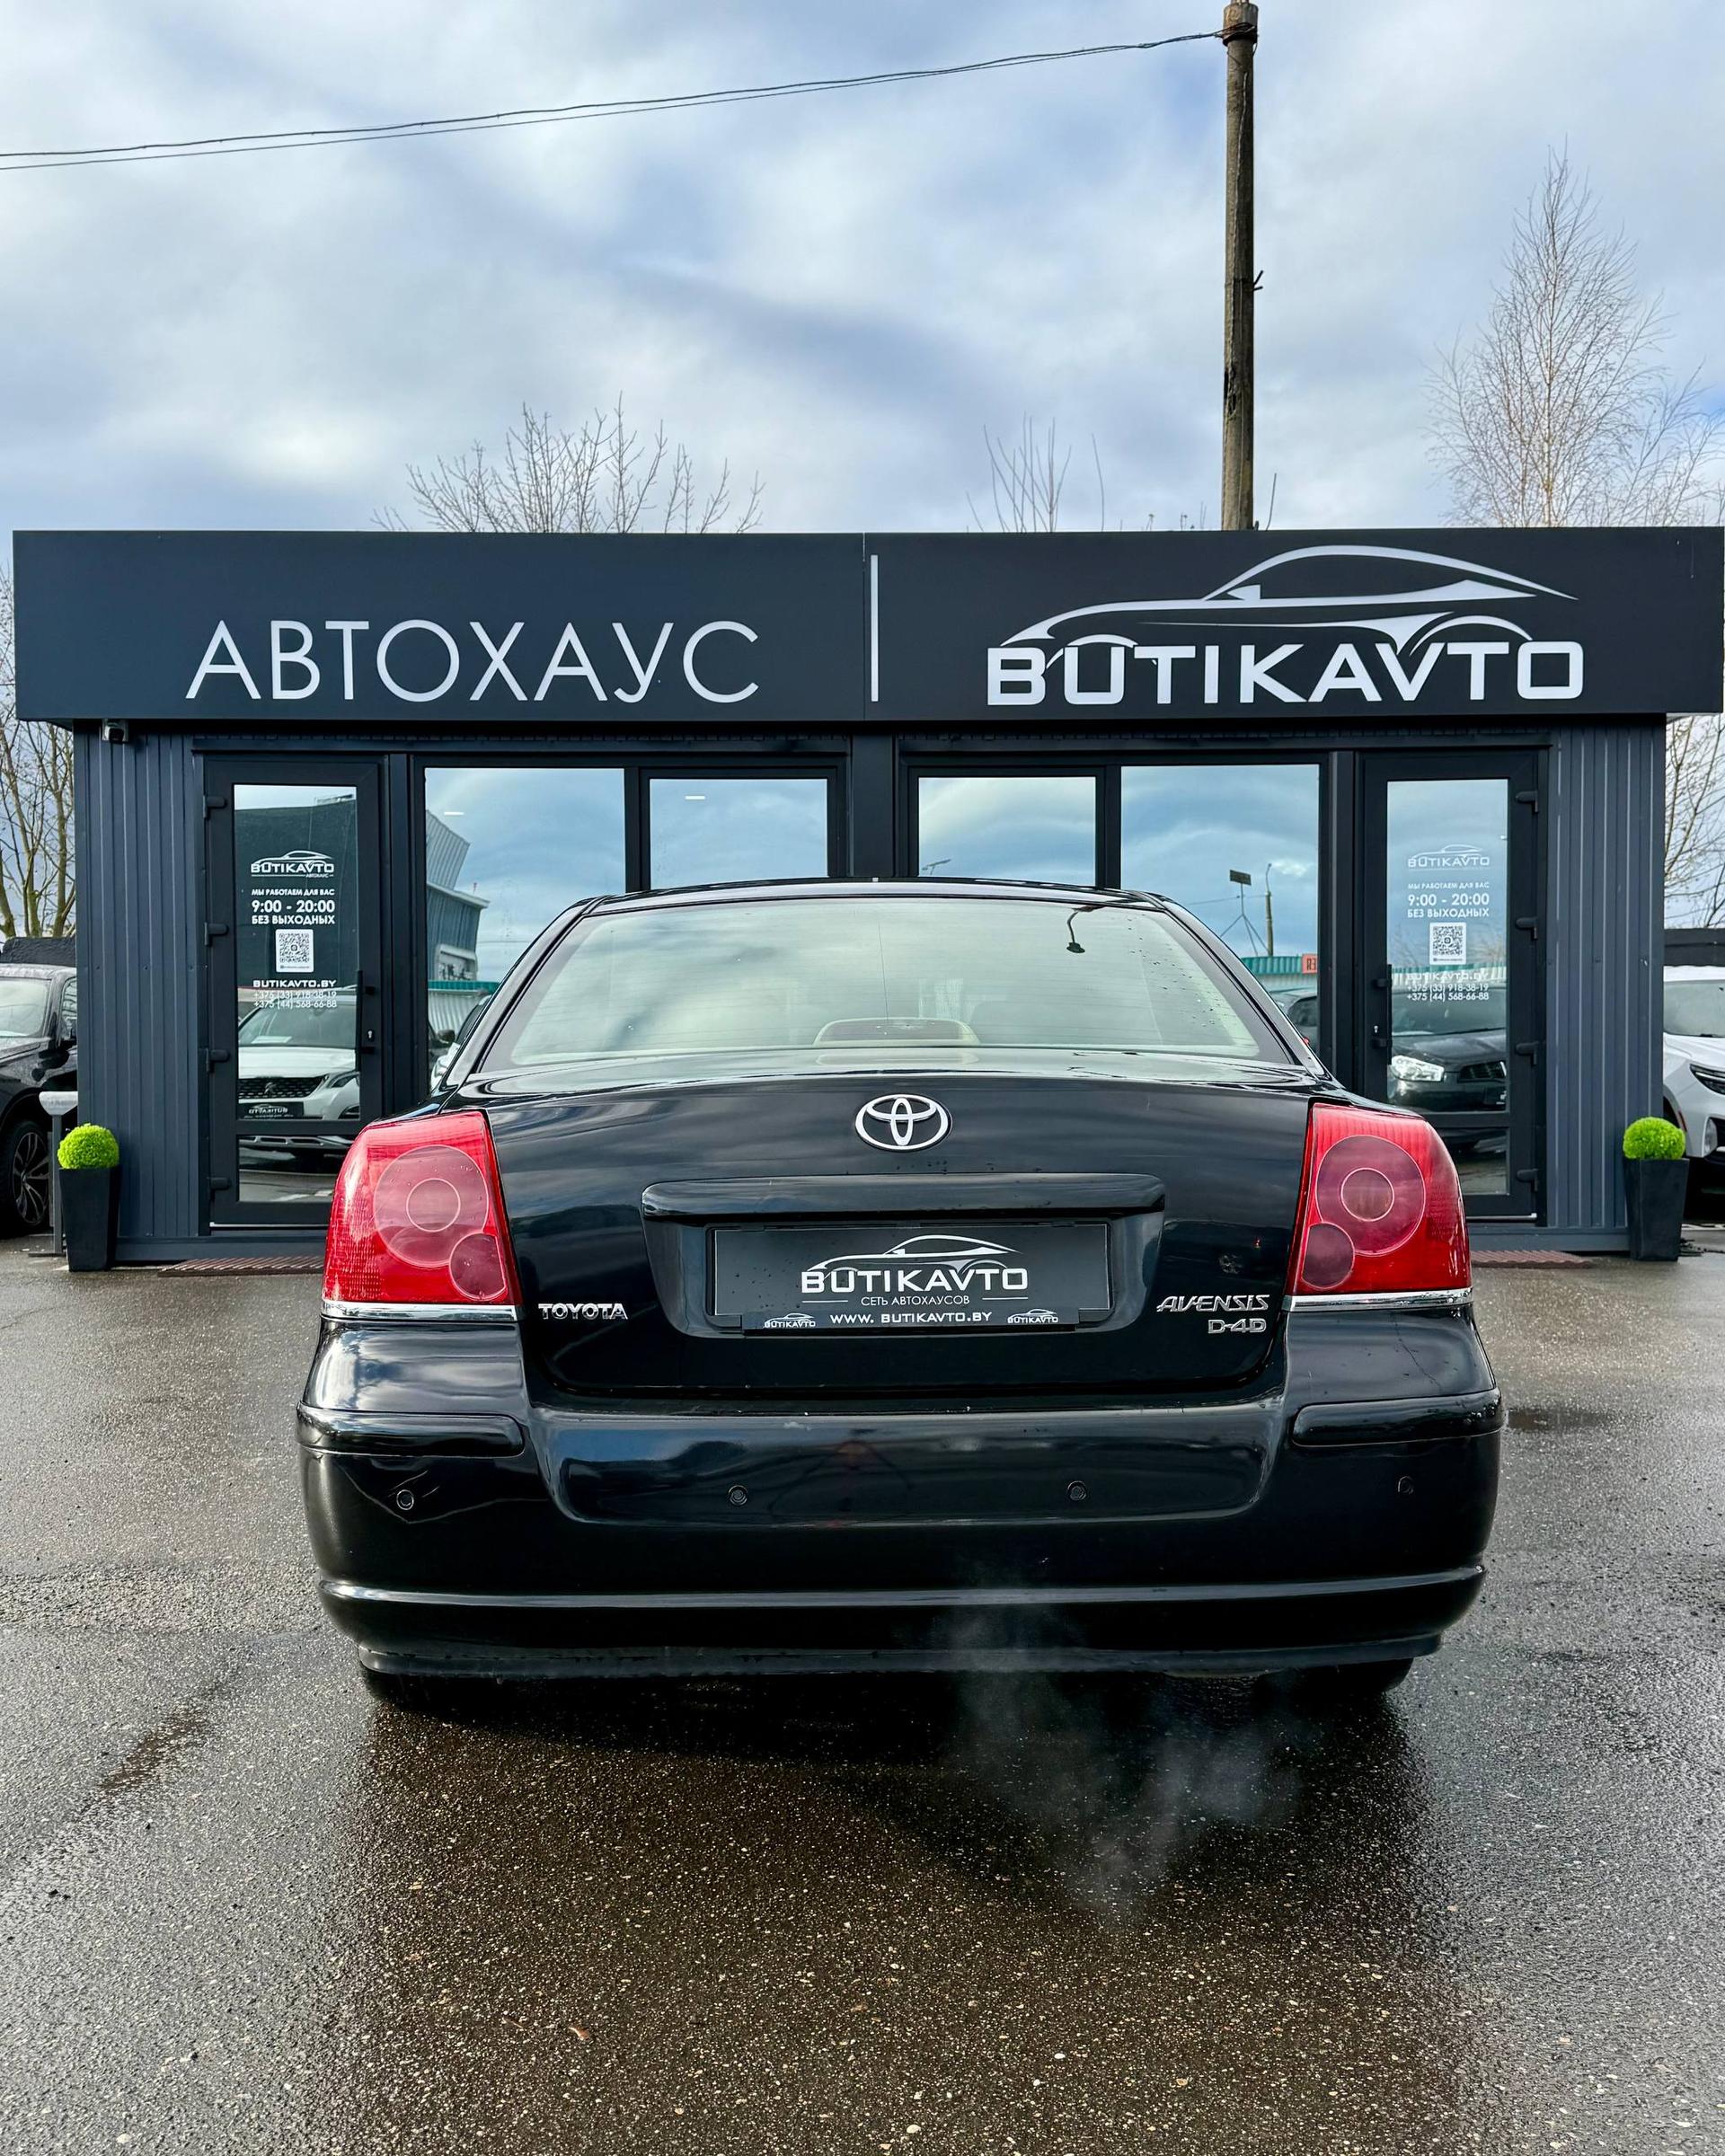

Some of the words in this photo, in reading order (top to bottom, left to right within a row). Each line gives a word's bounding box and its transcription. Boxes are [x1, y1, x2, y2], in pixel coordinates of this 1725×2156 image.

[185, 619, 759, 703] АВТОХАУС
[987, 641, 1584, 705] BUTIKAVTO
[251, 862, 334, 873] BUTIKAVTO
[1408, 856, 1491, 868] BUTIKAVTO
[1459, 881, 1473, 889] ДЛЯ
[304, 888, 318, 897] ДЛЯ
[1408, 894, 1437, 906] 9:00
[1451, 893, 1491, 906] 20:00
[252, 899, 282, 913] 9:00
[296, 899, 336, 913] 20:00
[1407, 908, 1424, 918] БЕЗ
[1427, 907, 1490, 918] ВЫХОДНЫХ
[252, 915, 270, 924] БЕЗ
[271, 915, 335, 925] ВЫХОДНЫХ
[1407, 984, 1427, 992] +375
[1429, 984, 1446, 994] (33)
[1447, 983, 1489, 992] 918-38-19
[1407, 993, 1428, 1001] +375
[1429, 993, 1446, 1003] (44)
[1447, 992, 1490, 1001] 568-66-88
[253, 1000, 274, 1008] +375
[278, 1000, 293, 1010] (44)
[296, 999, 337, 1008] 568-66-88
[801, 1268, 1028, 1294] BUTIKAVTO
[861, 1296, 889, 1306] СЕТЬ
[891, 1295, 970, 1306] АВТОХАУСОВ
[1155, 1294, 1269, 1312] AVENSIS
[538, 1303, 628, 1320] TOYOTA
[829, 1313, 874, 1324] WWW.
[880, 1312, 993, 1323] BUTIKAVTO.BY
[1007, 1316, 1059, 1324] BUTIKAVTO
[764, 1320, 817, 1329] BUTIKAVTO
[1208, 1318, 1267, 1334] D-4D
